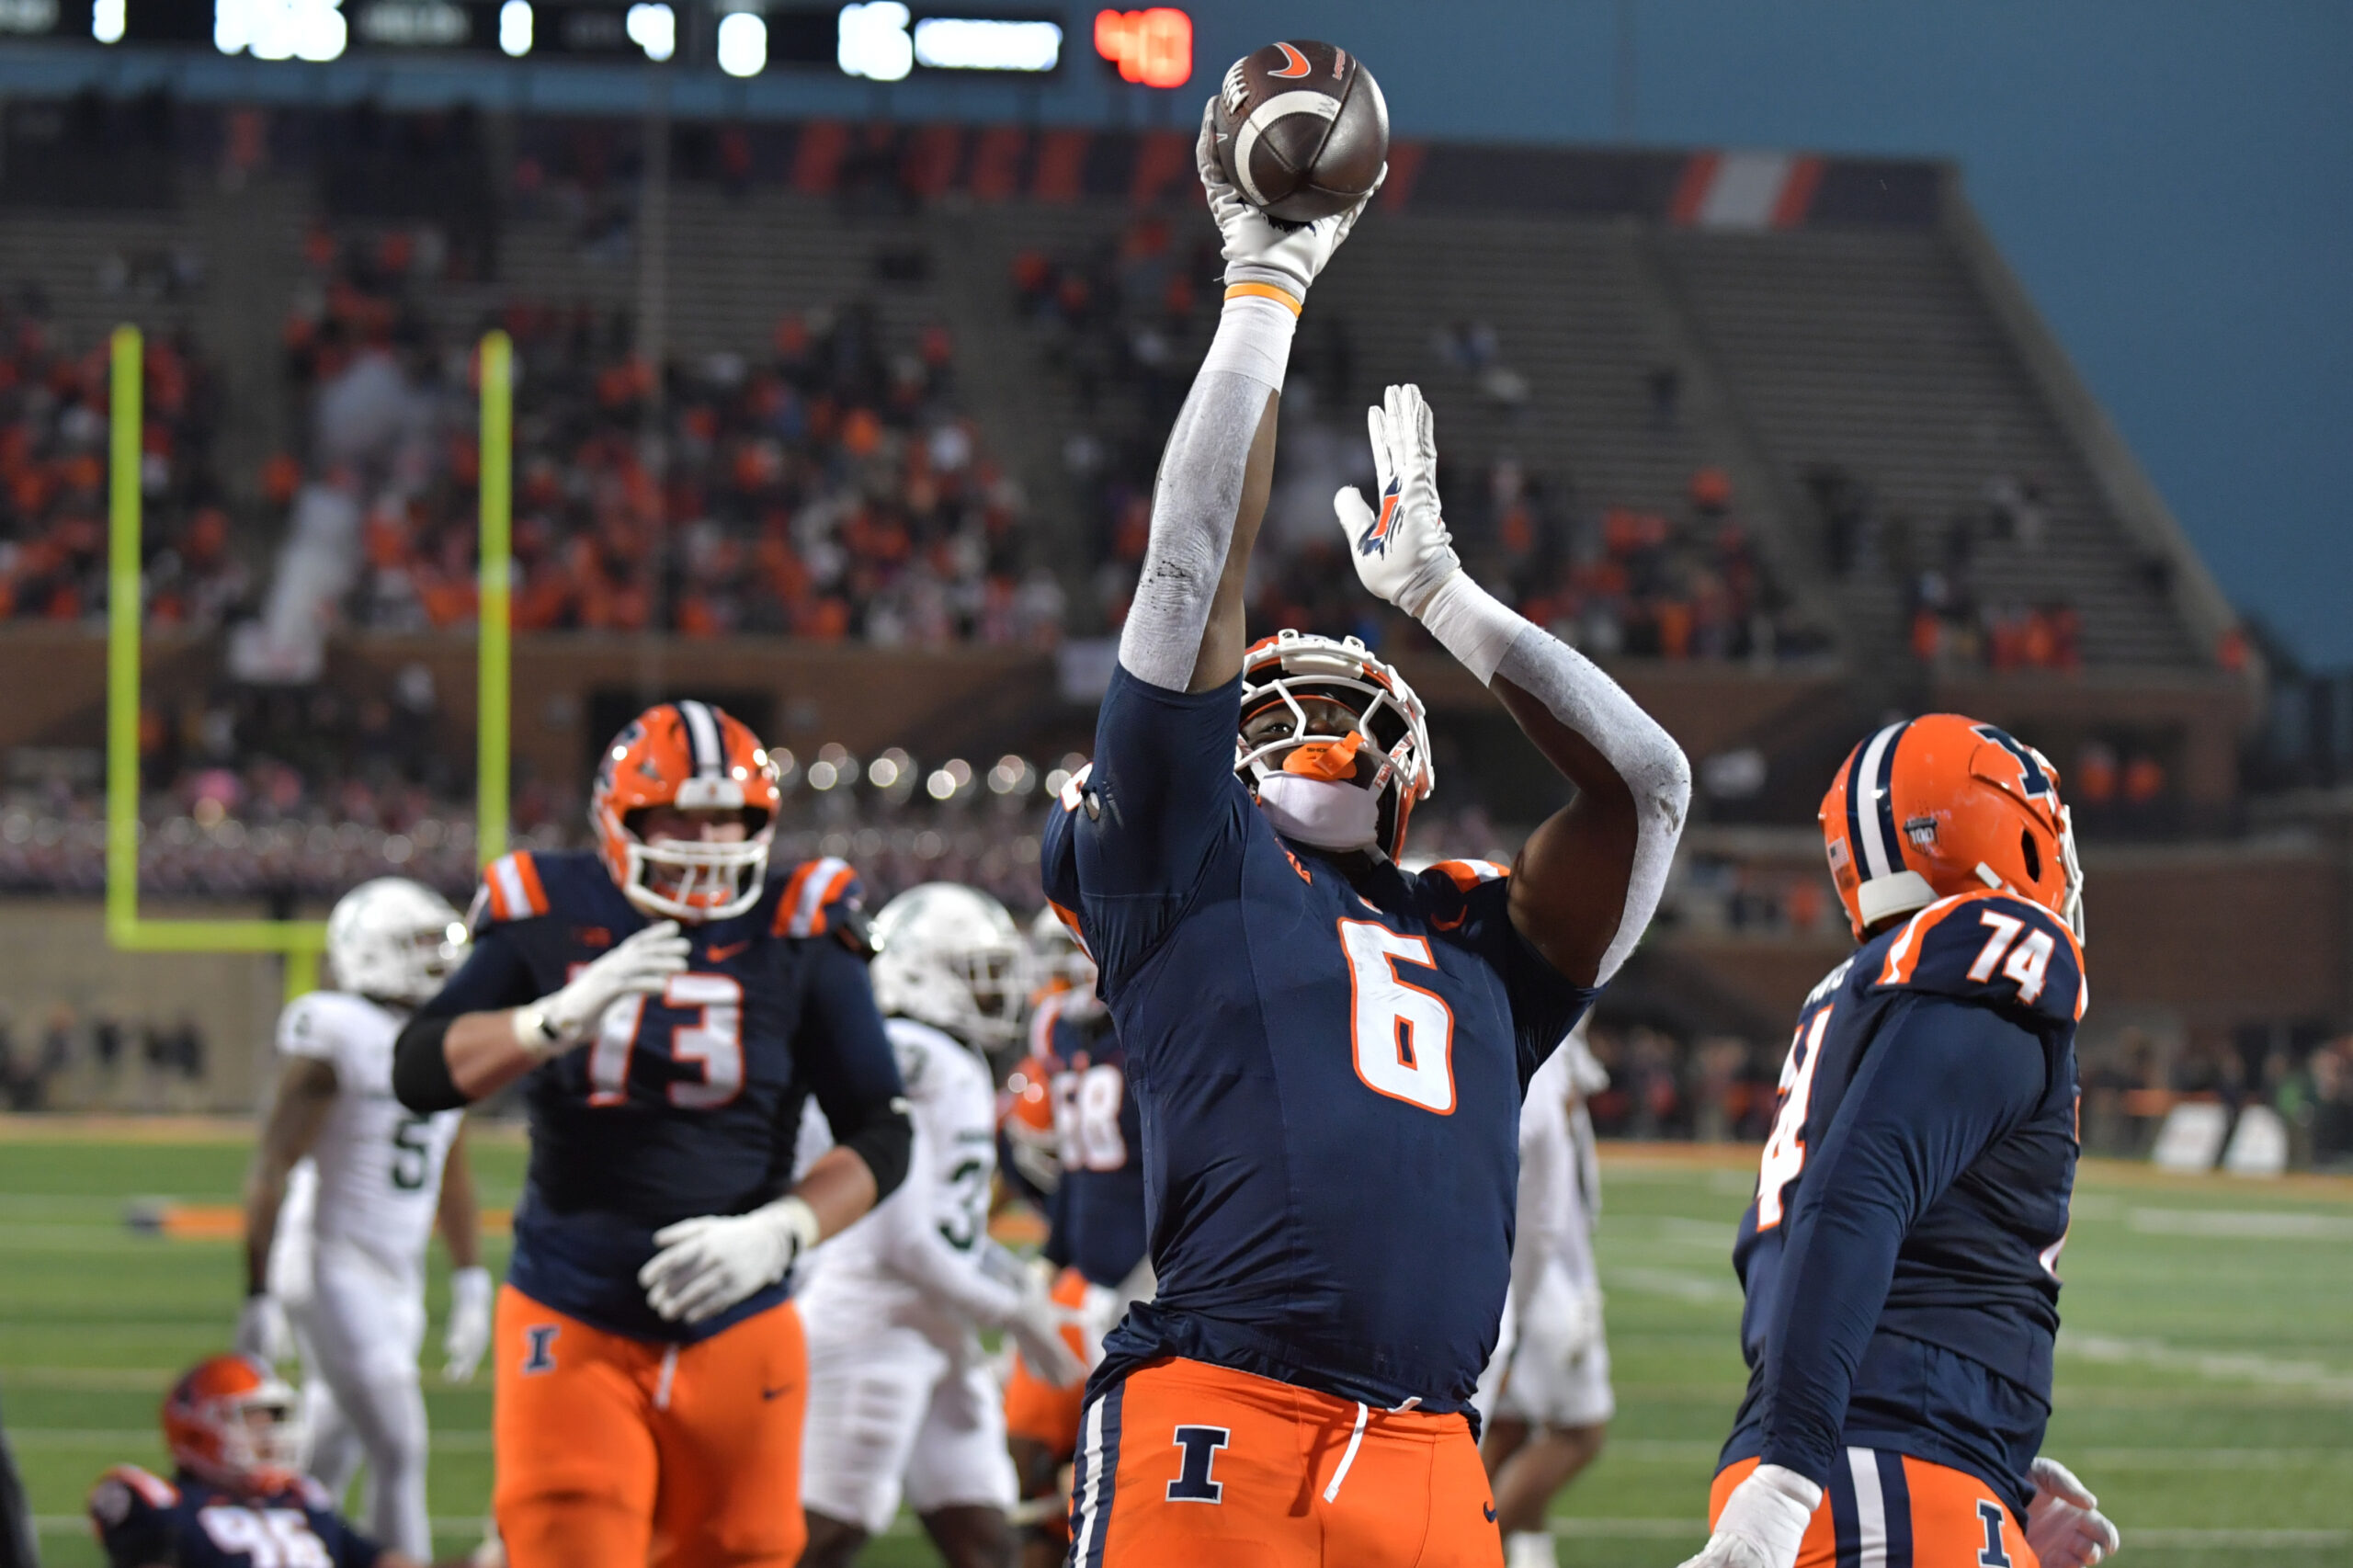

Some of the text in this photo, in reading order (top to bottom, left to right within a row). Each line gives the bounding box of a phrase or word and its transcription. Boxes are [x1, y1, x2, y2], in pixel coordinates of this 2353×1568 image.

[1909, 826, 1935, 845] 100
[1966, 907, 2055, 1006] 74
[1336, 915, 1457, 1117] 6
[523, 1324, 560, 1376] I
[1165, 1425, 1231, 1505] I
[1976, 1498, 2012, 1568] I
